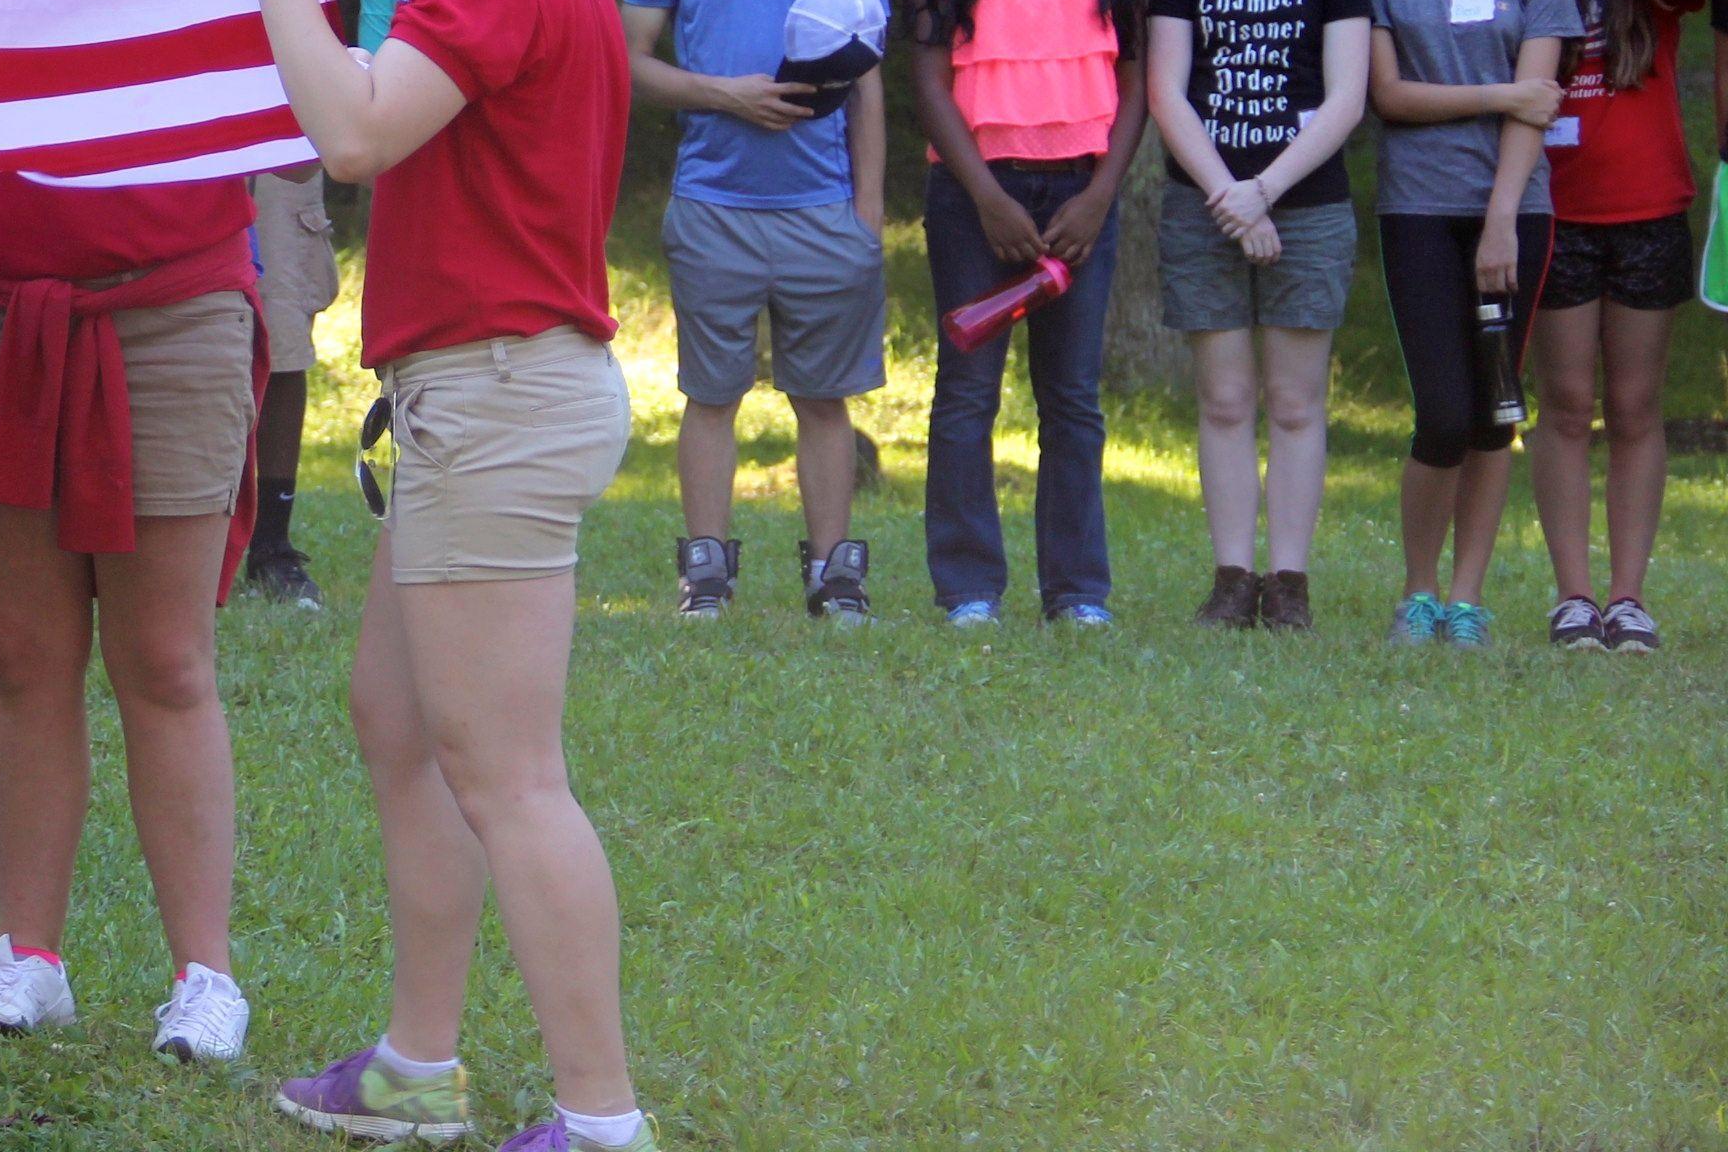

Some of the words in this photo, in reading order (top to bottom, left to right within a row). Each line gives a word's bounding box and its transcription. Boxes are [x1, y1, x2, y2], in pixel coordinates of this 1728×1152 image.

[1201, 15, 1306, 48] Prisoner
[1215, 68, 1288, 95] Order
[1571, 73, 1603, 87] 2007
[1208, 93, 1289, 117] Prince
[1204, 119, 1298, 148] Hallows
